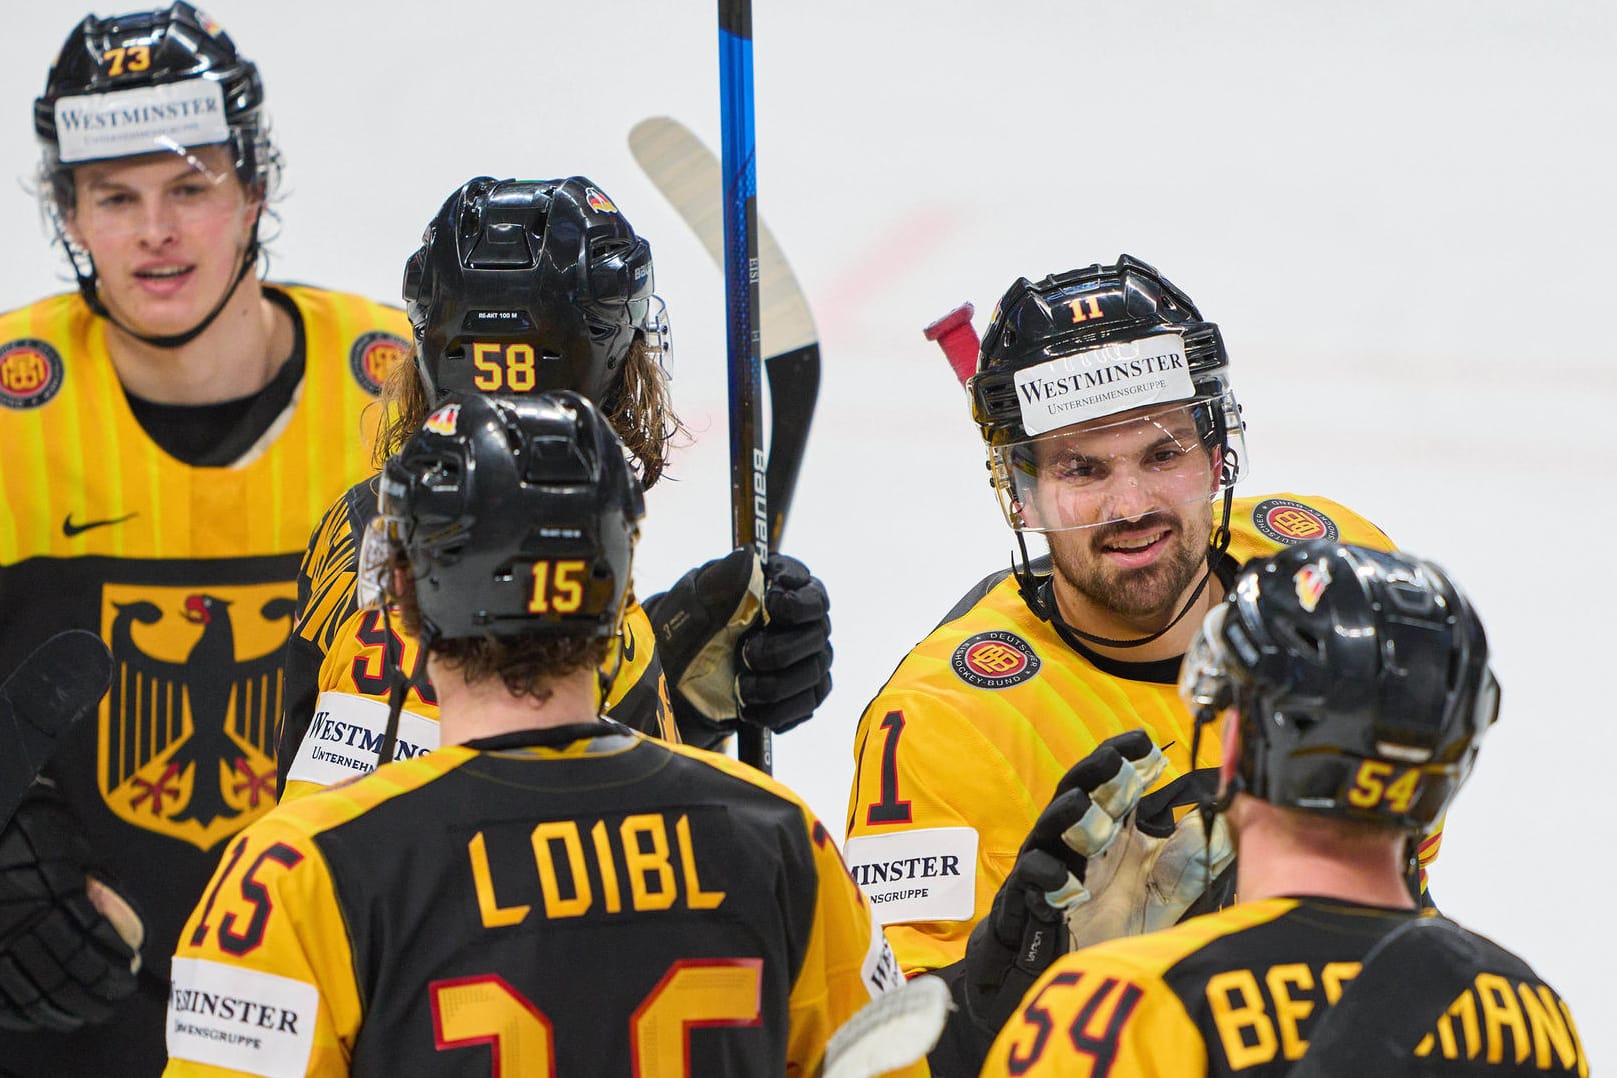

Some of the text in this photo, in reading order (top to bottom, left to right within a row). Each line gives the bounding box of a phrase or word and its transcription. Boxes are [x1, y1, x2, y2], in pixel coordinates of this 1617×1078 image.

[103, 45, 150, 77] 73
[60, 96, 218, 130] WESTMINSTER
[1069, 298, 1104, 324] 11
[472, 342, 536, 392] 58
[1020, 353, 1183, 405] WESTMINSTER
[1047, 379, 1167, 415] UNTERNEHMENSGRUPPE
[529, 560, 586, 614] 15
[351, 606, 440, 707] 5
[1349, 760, 1421, 812] 54
[190, 836, 305, 958] 15
[468, 813, 726, 929] LOIBL
[1007, 972, 1144, 1078] 54
